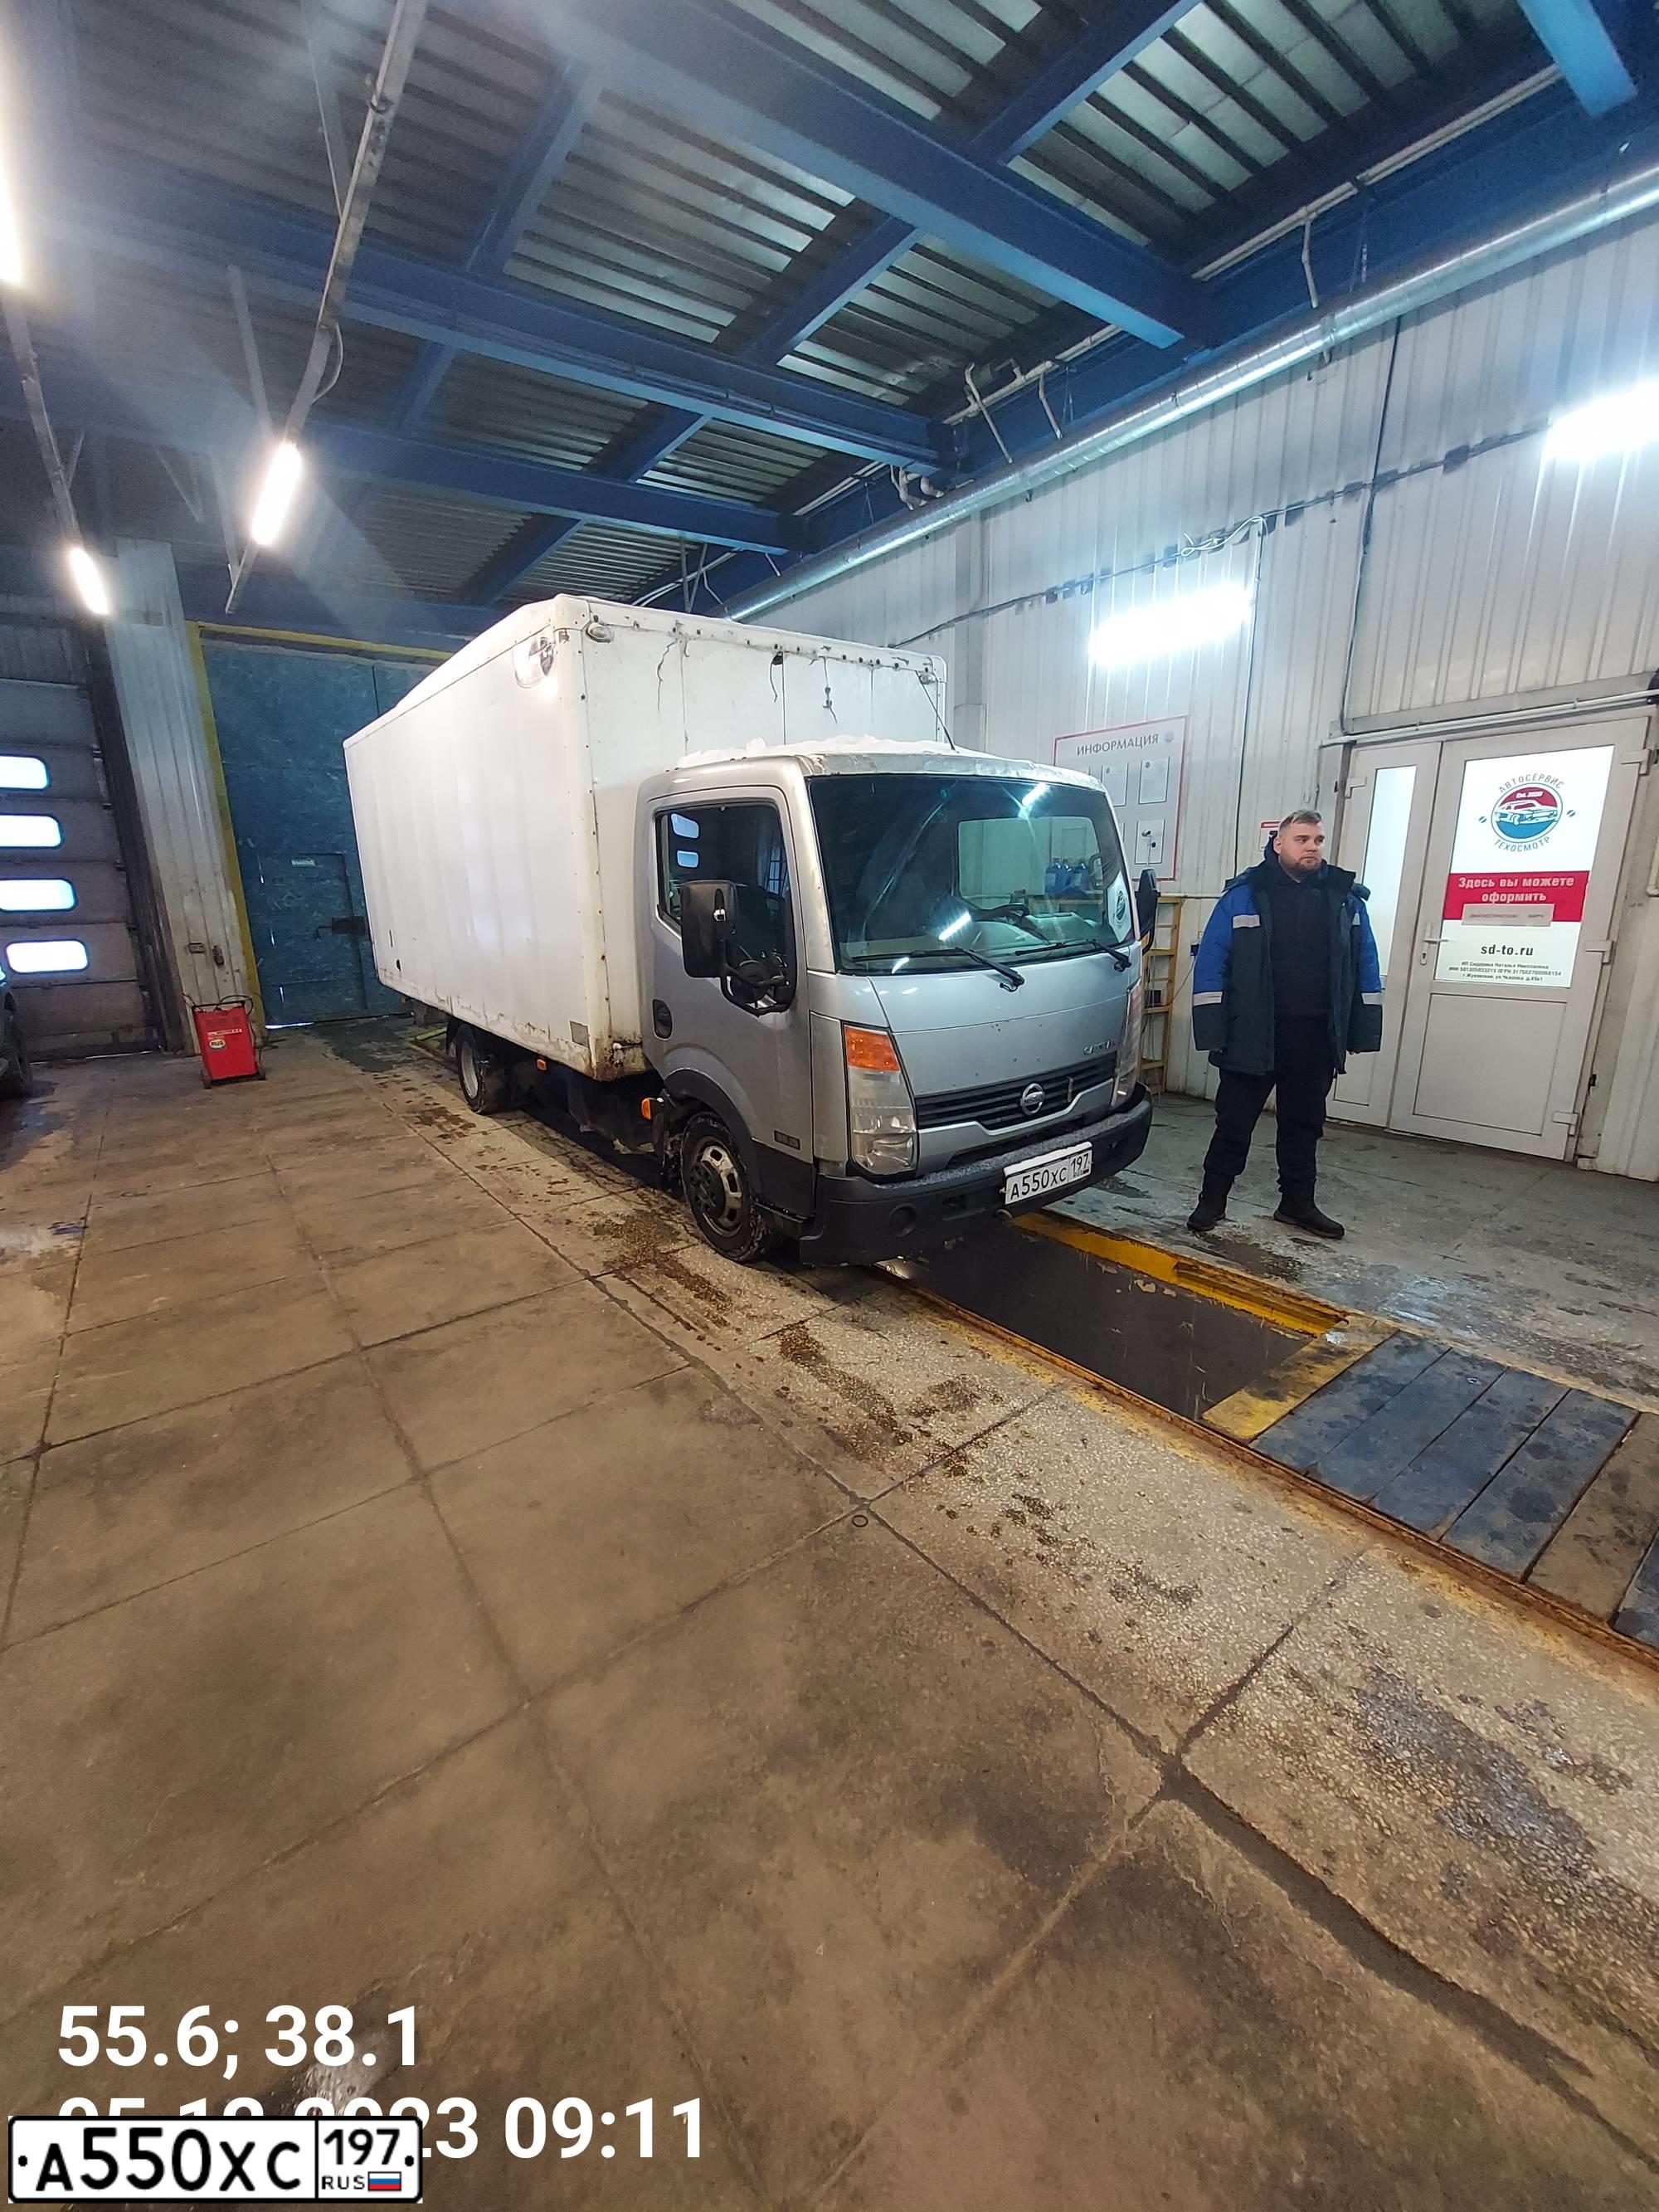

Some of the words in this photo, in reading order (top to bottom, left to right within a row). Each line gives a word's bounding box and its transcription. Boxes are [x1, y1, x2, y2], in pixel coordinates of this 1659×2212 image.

[1077, 734, 1159, 756] ИНФОРМАЦИЯ
[1499, 773, 1564, 792] АВТОСЕРВИС
[1494, 836, 1550, 852] ТЕХОСМОТР
[1458, 877, 1495, 889] Здесь
[1499, 878, 1518, 887] вы
[1522, 877, 1574, 887] можете
[1481, 891, 1546, 904] оформить
[1481, 944, 1534, 956] sd-to.ru
[1070, 1153, 1088, 1175] 197
